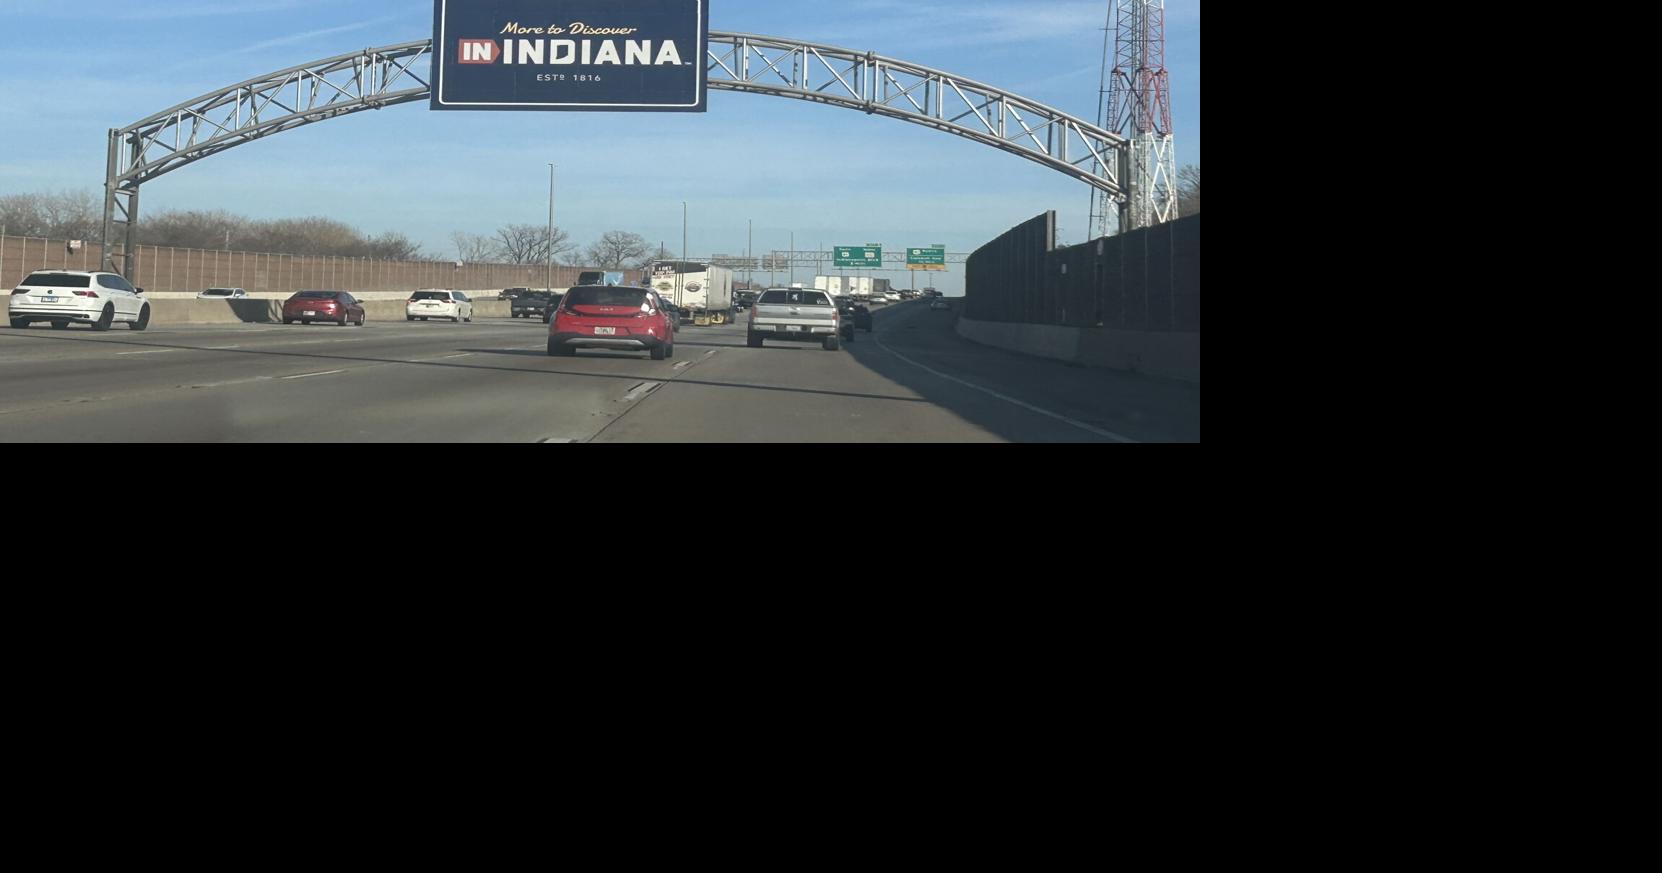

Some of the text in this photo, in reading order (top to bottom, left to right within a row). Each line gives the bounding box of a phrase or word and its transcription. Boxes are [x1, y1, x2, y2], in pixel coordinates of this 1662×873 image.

[500, 22, 637, 35] More to Discover
[463, 39, 682, 65] IN INDIANA
